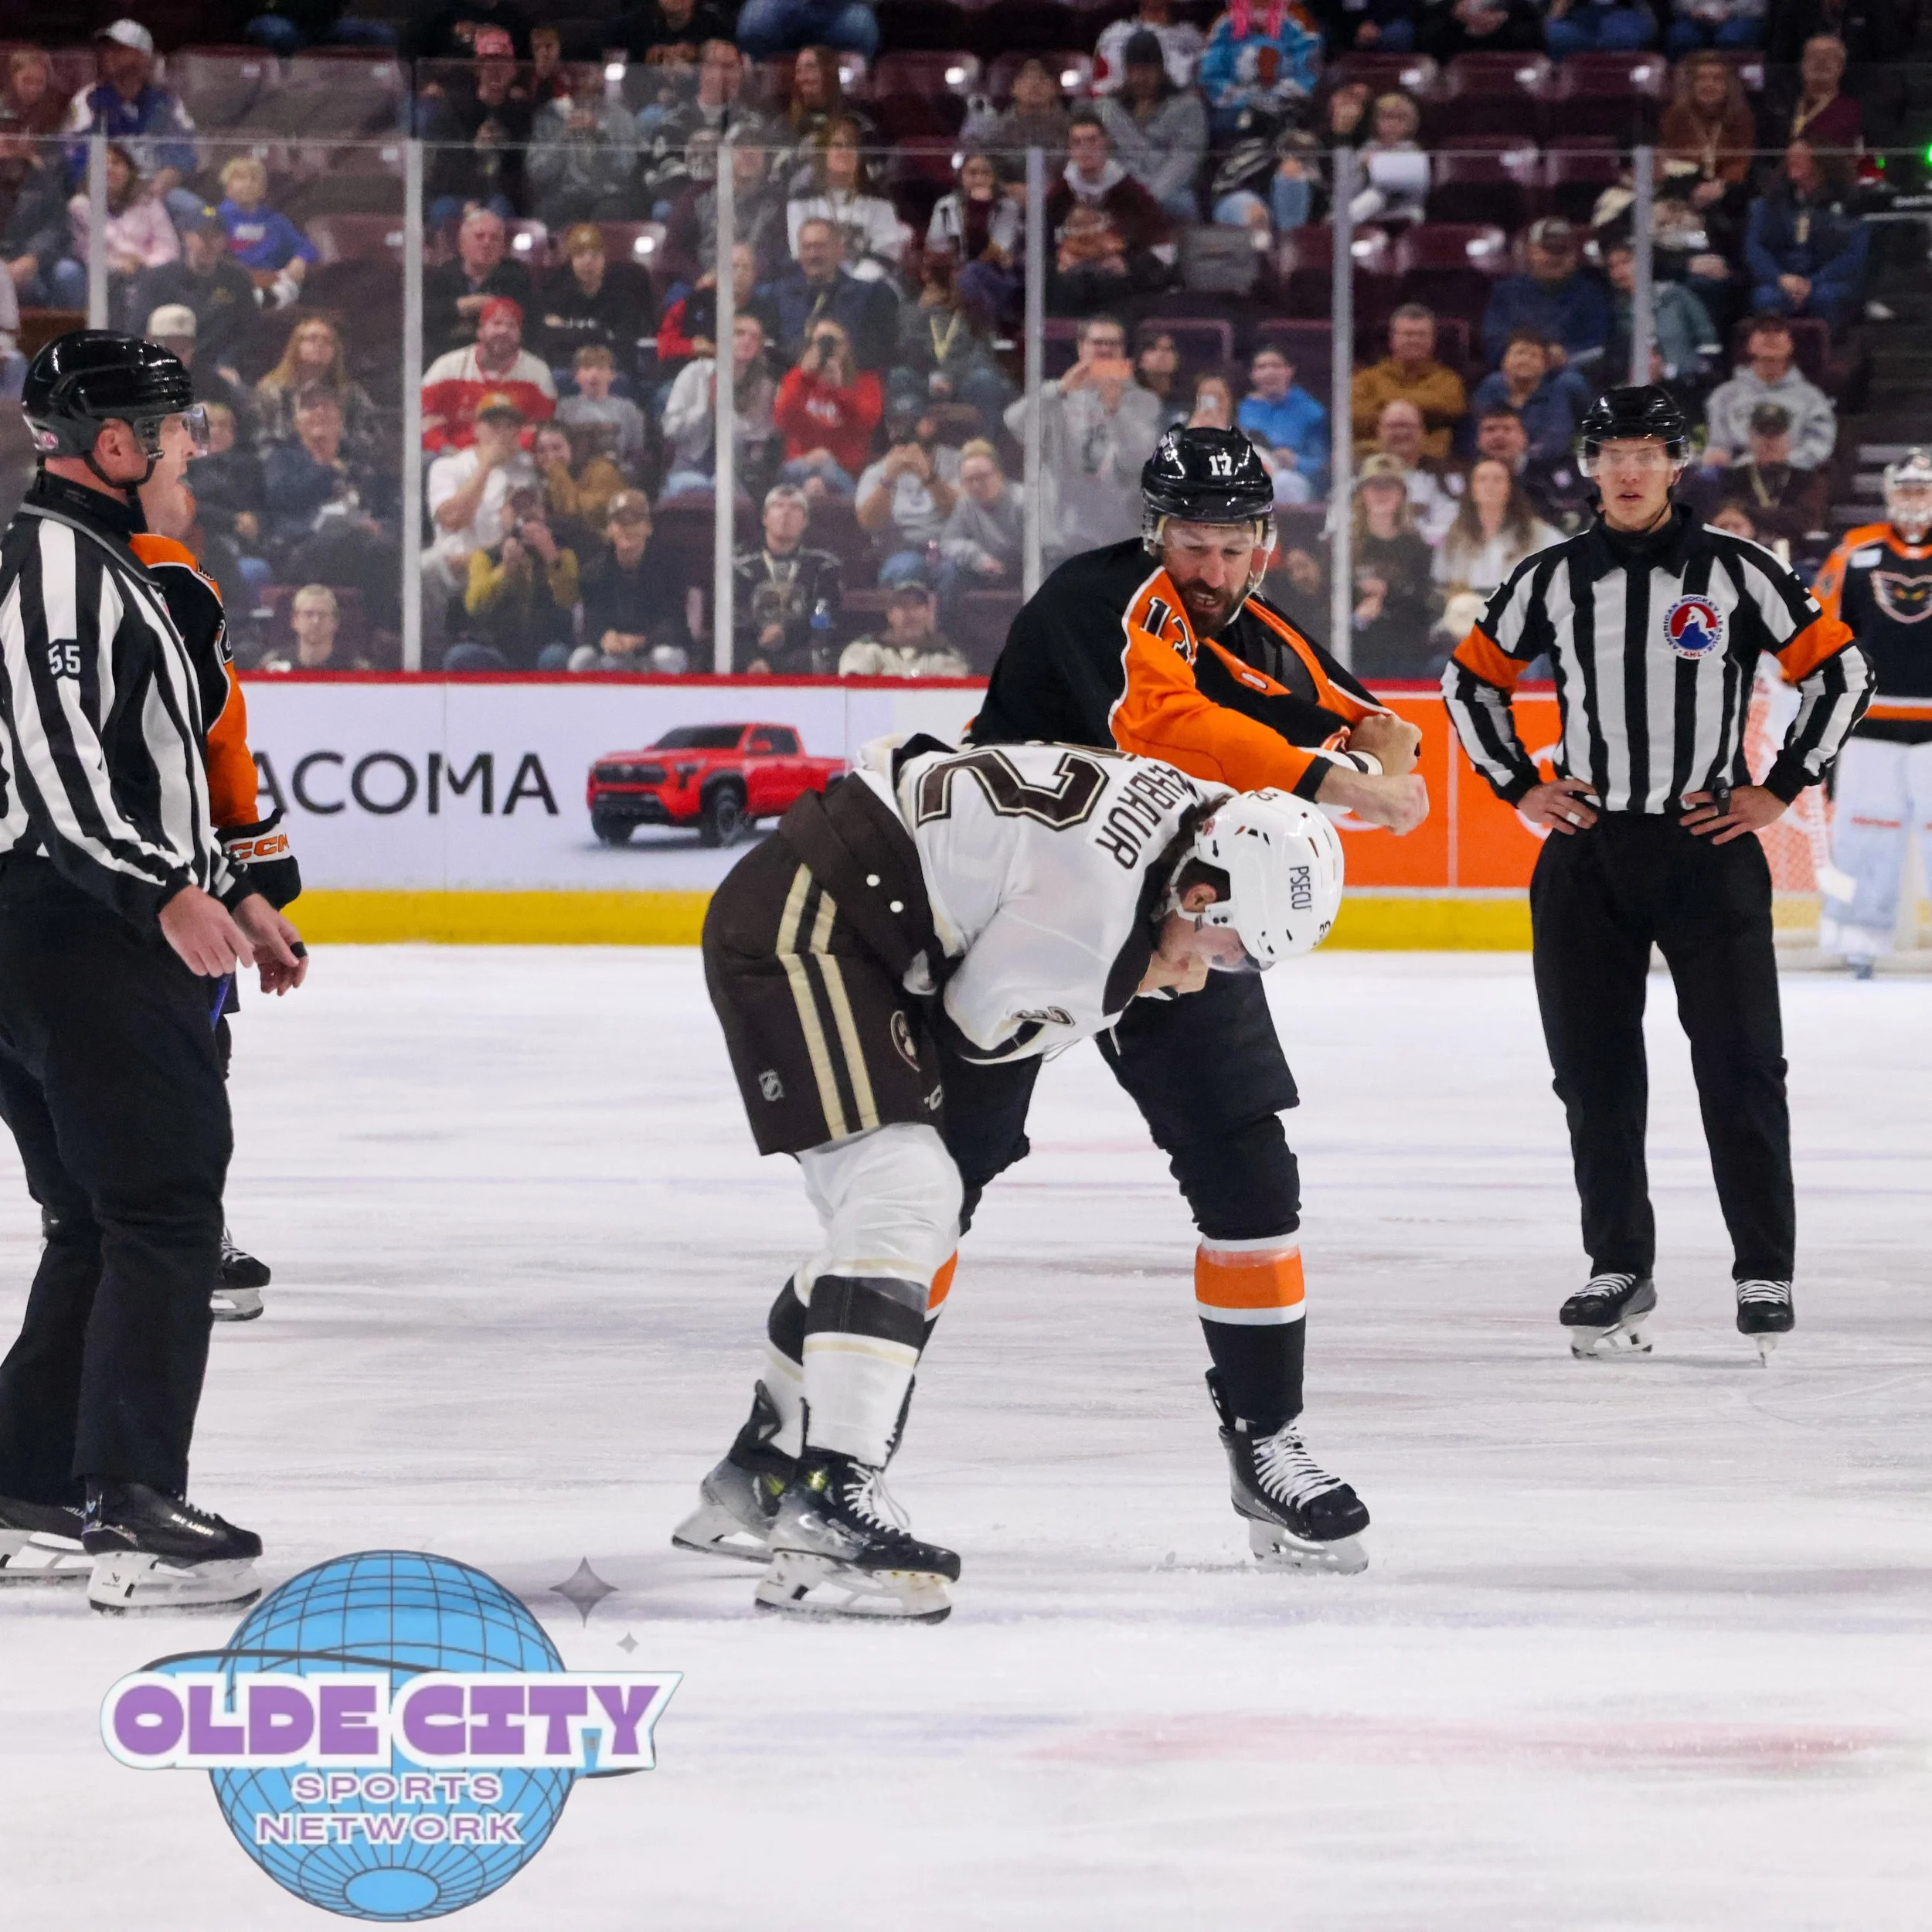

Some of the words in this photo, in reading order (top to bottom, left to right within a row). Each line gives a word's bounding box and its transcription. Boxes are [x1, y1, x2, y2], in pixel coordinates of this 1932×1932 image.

[1208, 454, 1233, 476] 17
[1663, 602, 1679, 650] AMERICAN
[1680, 595, 1719, 611] HOCKEY
[1706, 614, 1724, 652] LEAGUE
[47, 644, 81, 674] 55
[230, 833, 289, 859] CCM
[1289, 866, 1312, 911] PSECU
